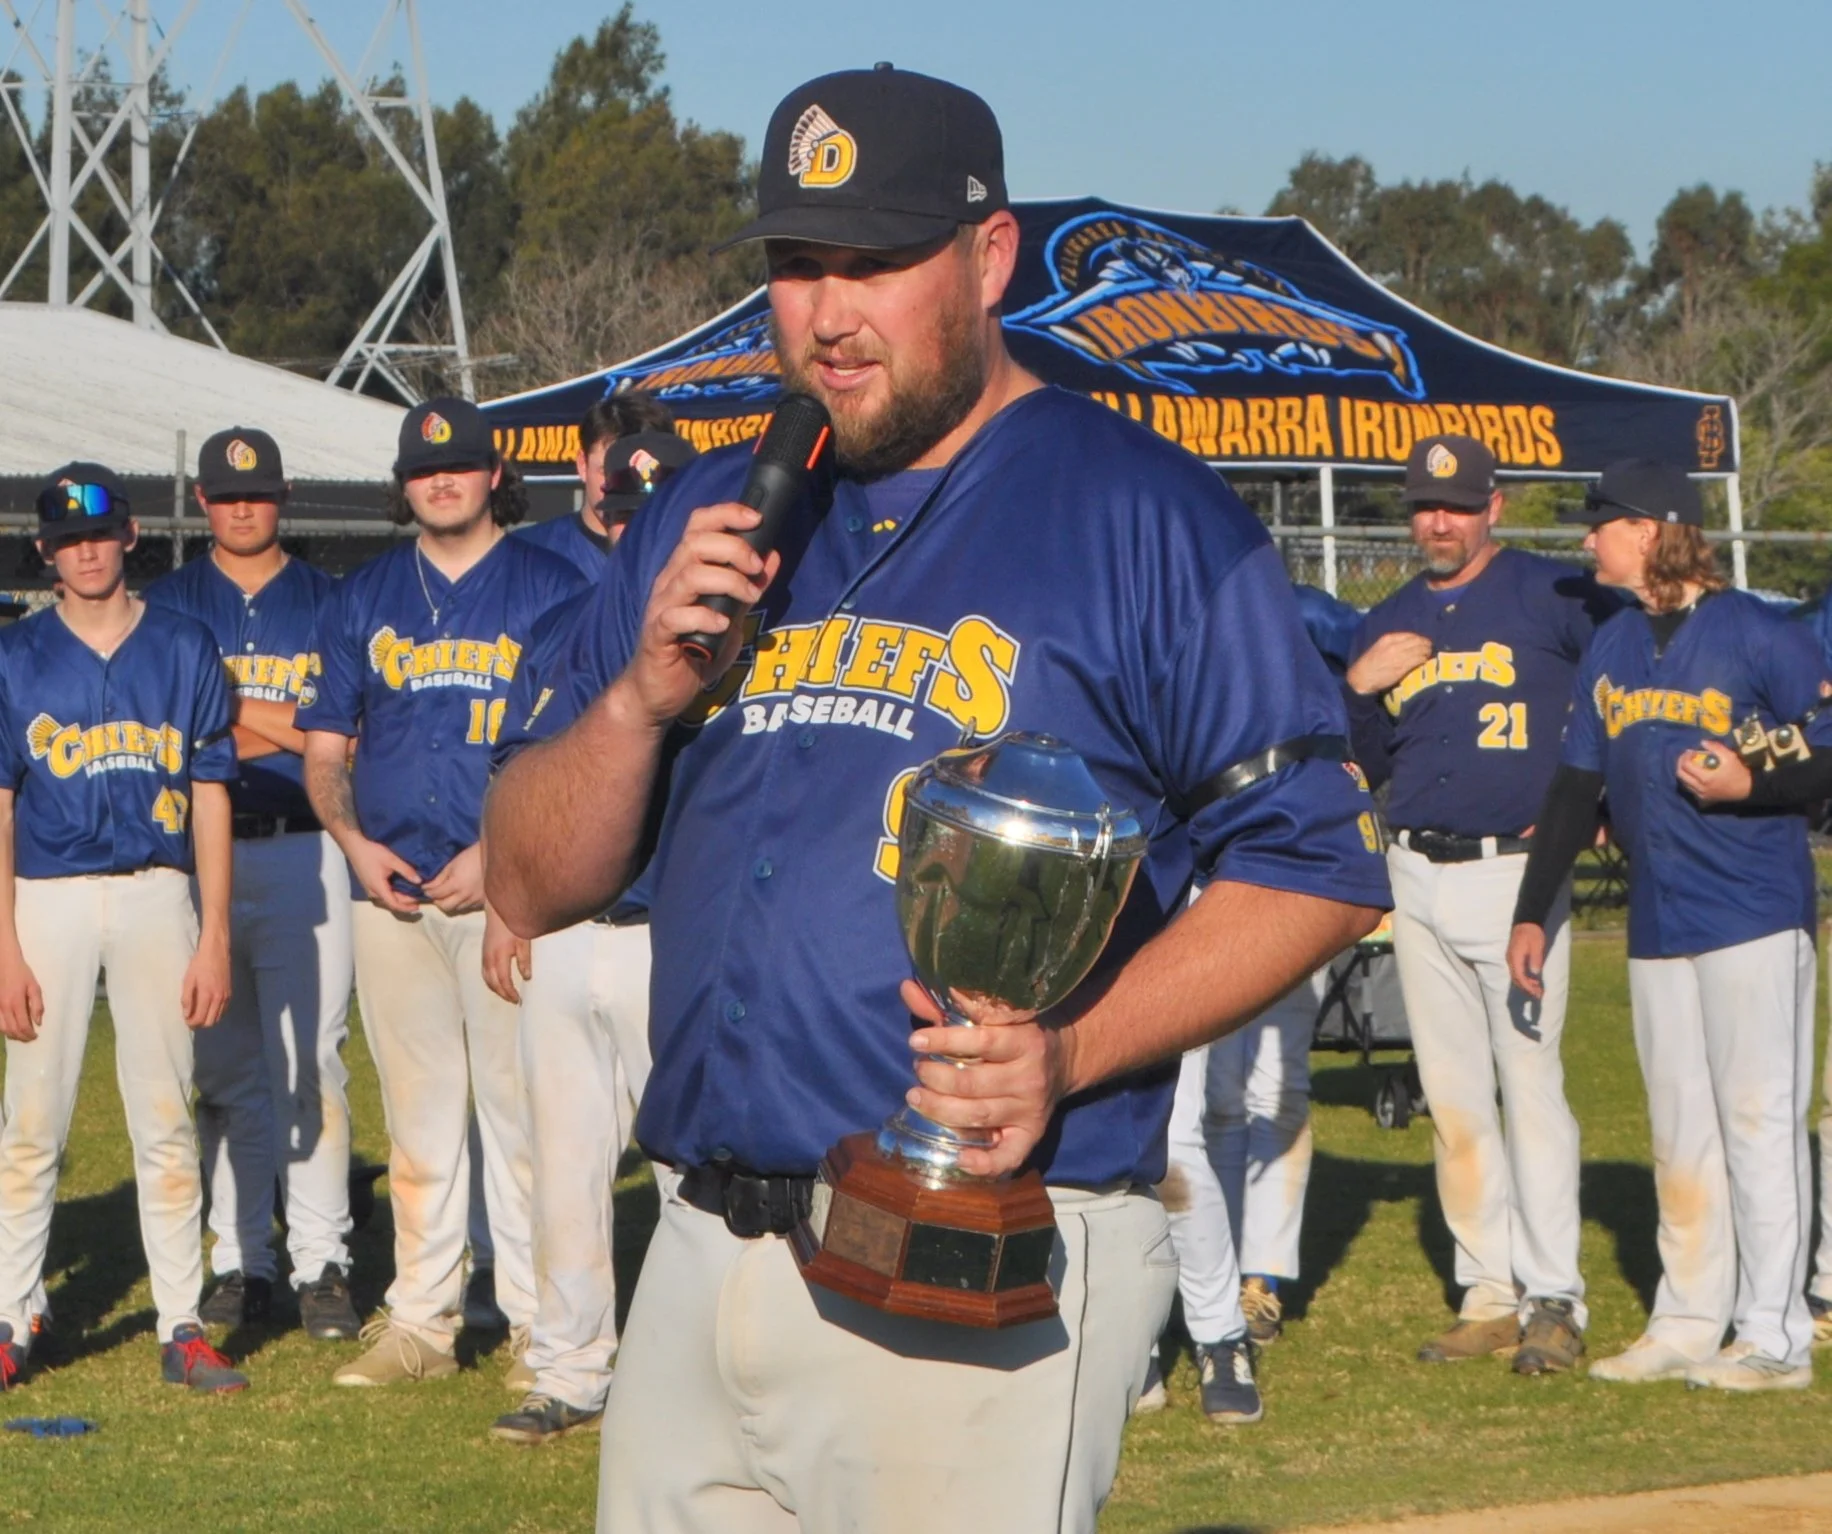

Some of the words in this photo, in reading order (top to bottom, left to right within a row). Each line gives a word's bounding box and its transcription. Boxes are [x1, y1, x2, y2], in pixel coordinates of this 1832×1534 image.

[382, 633, 523, 691] CHIEFS
[410, 671, 493, 693] BASEBALL
[741, 694, 915, 742] BASEBALL
[1477, 702, 1529, 750] 21
[1605, 685, 1732, 739] CHIEFS
[46, 721, 184, 780] CHIEFS
